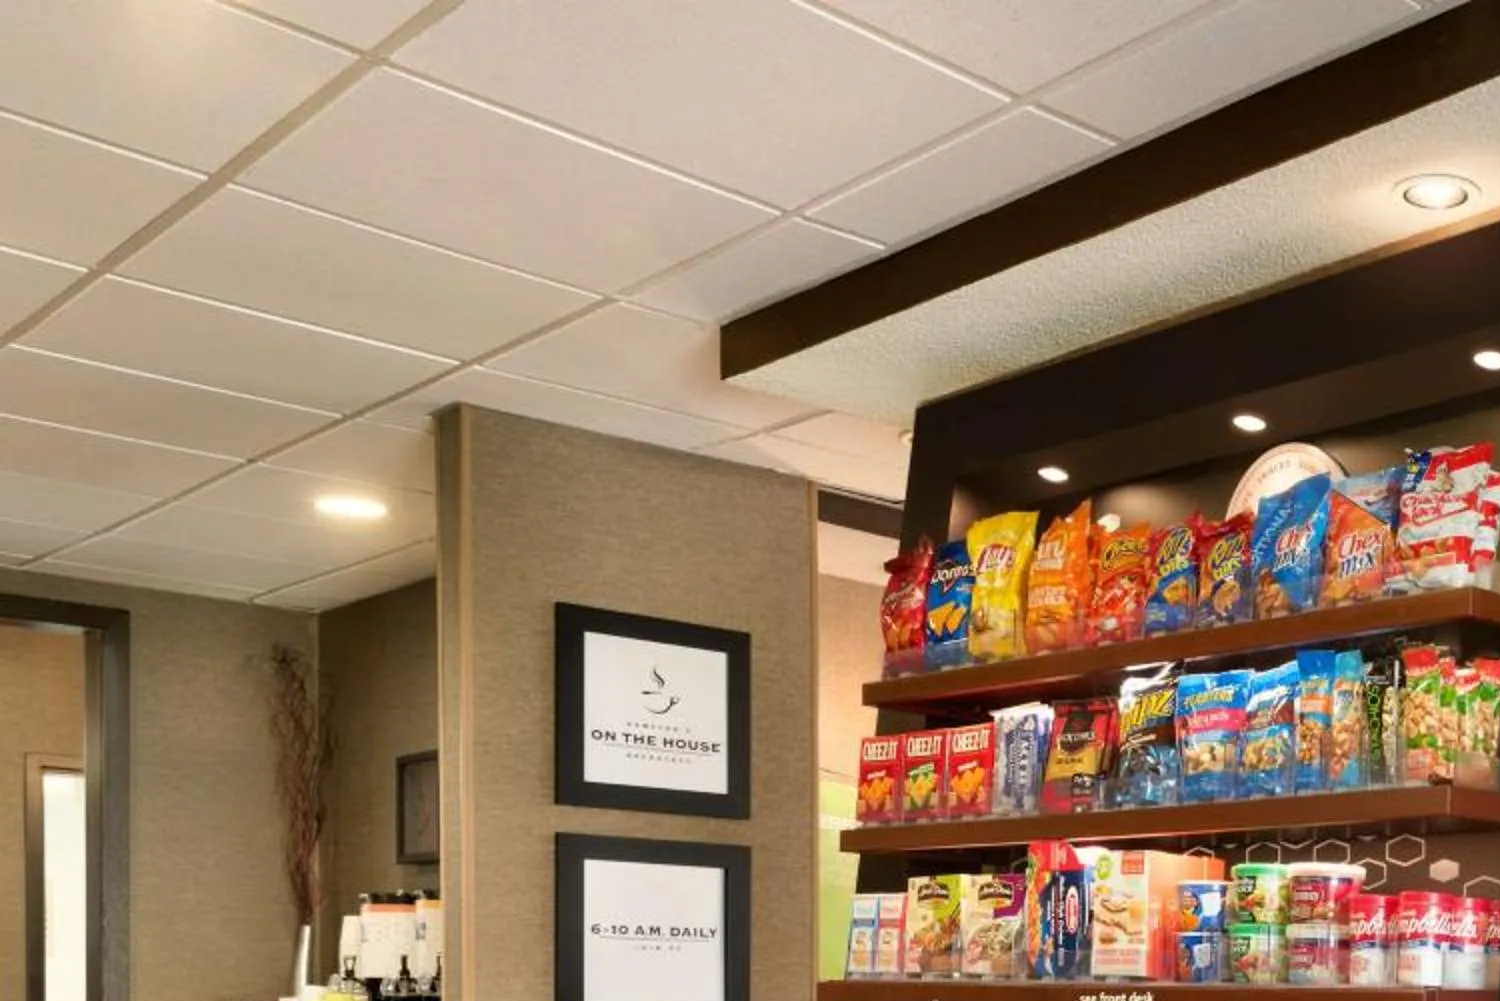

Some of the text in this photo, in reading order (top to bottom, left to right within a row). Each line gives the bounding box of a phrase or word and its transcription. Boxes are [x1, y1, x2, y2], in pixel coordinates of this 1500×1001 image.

[1340, 531, 1382, 559] Chex
[591, 729, 721, 753] ON THE HOUSE
[669, 927, 718, 939] DAILY
